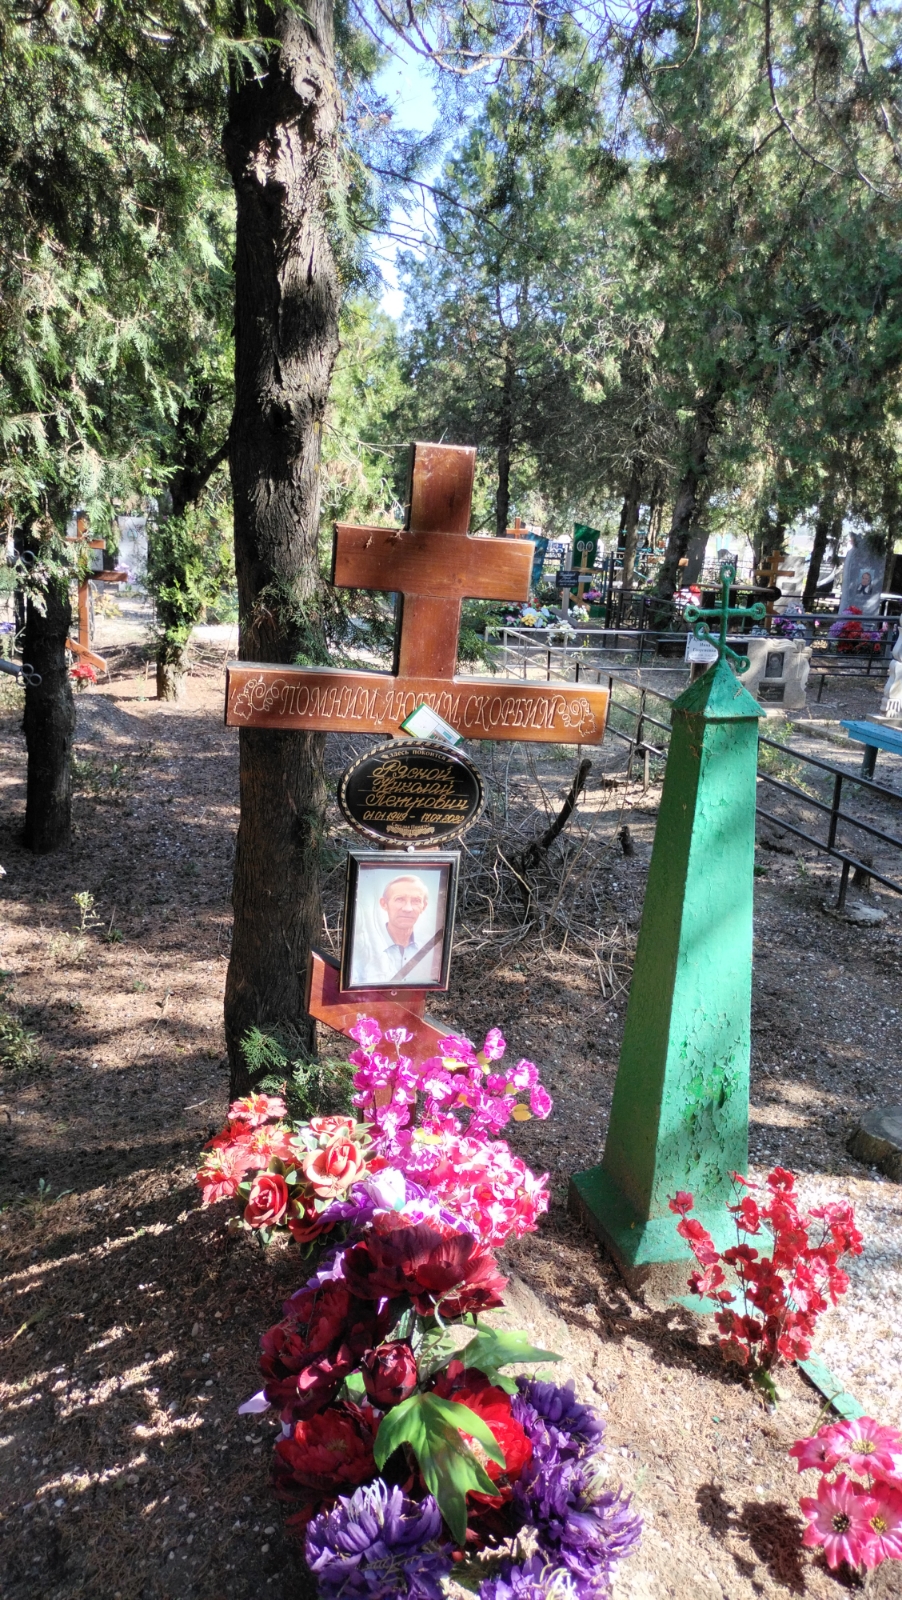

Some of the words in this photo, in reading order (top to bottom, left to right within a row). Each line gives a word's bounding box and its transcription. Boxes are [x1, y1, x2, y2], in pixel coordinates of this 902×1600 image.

[279, 684, 379, 725] ПОМНИМ,
[463, 694, 556, 732] СКОРБИМ
[372, 777, 456, 795] Николай
[365, 791, 470, 814] Петрович
